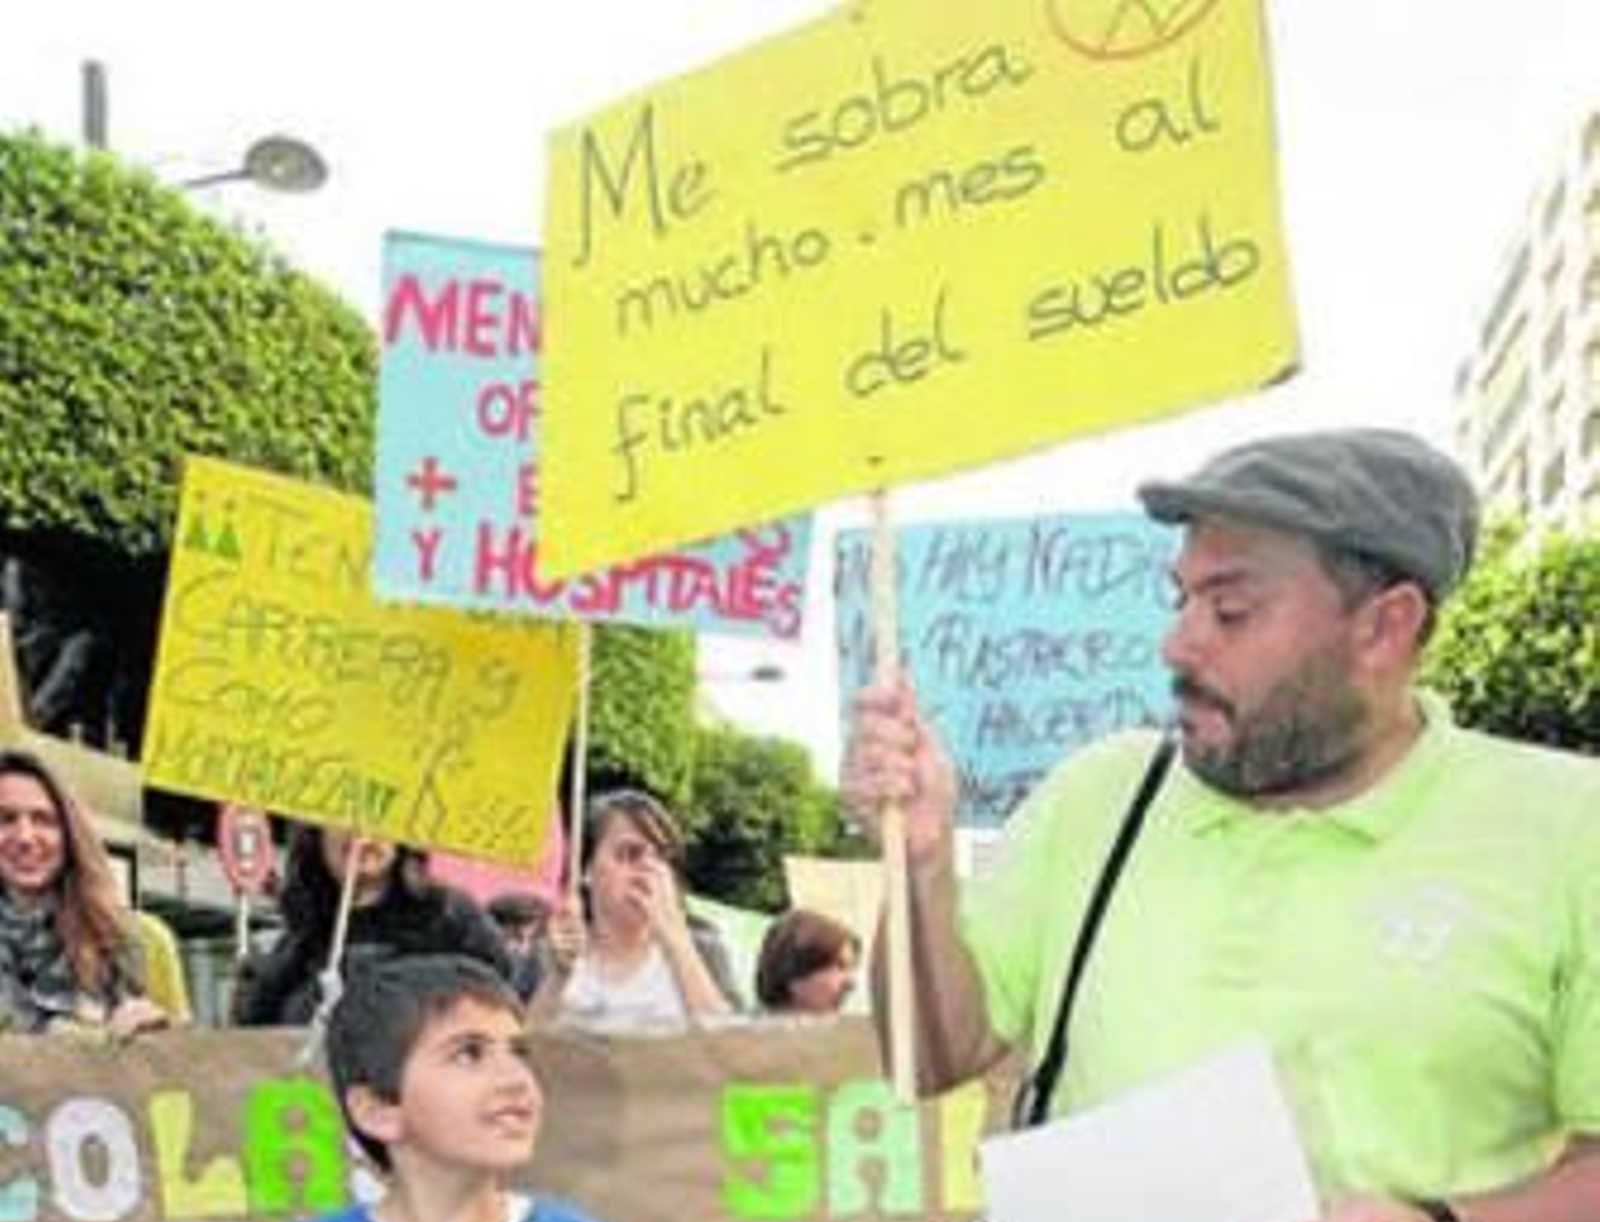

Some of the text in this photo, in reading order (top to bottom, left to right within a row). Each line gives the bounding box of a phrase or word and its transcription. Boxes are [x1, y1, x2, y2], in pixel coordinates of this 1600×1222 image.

[570, 42, 1033, 268] Me sobra
[894, 144, 1046, 230] mes
[1116, 58, 1221, 154] al
[612, 215, 1261, 504] final del sueldo
[412, 528, 442, 584] Y
